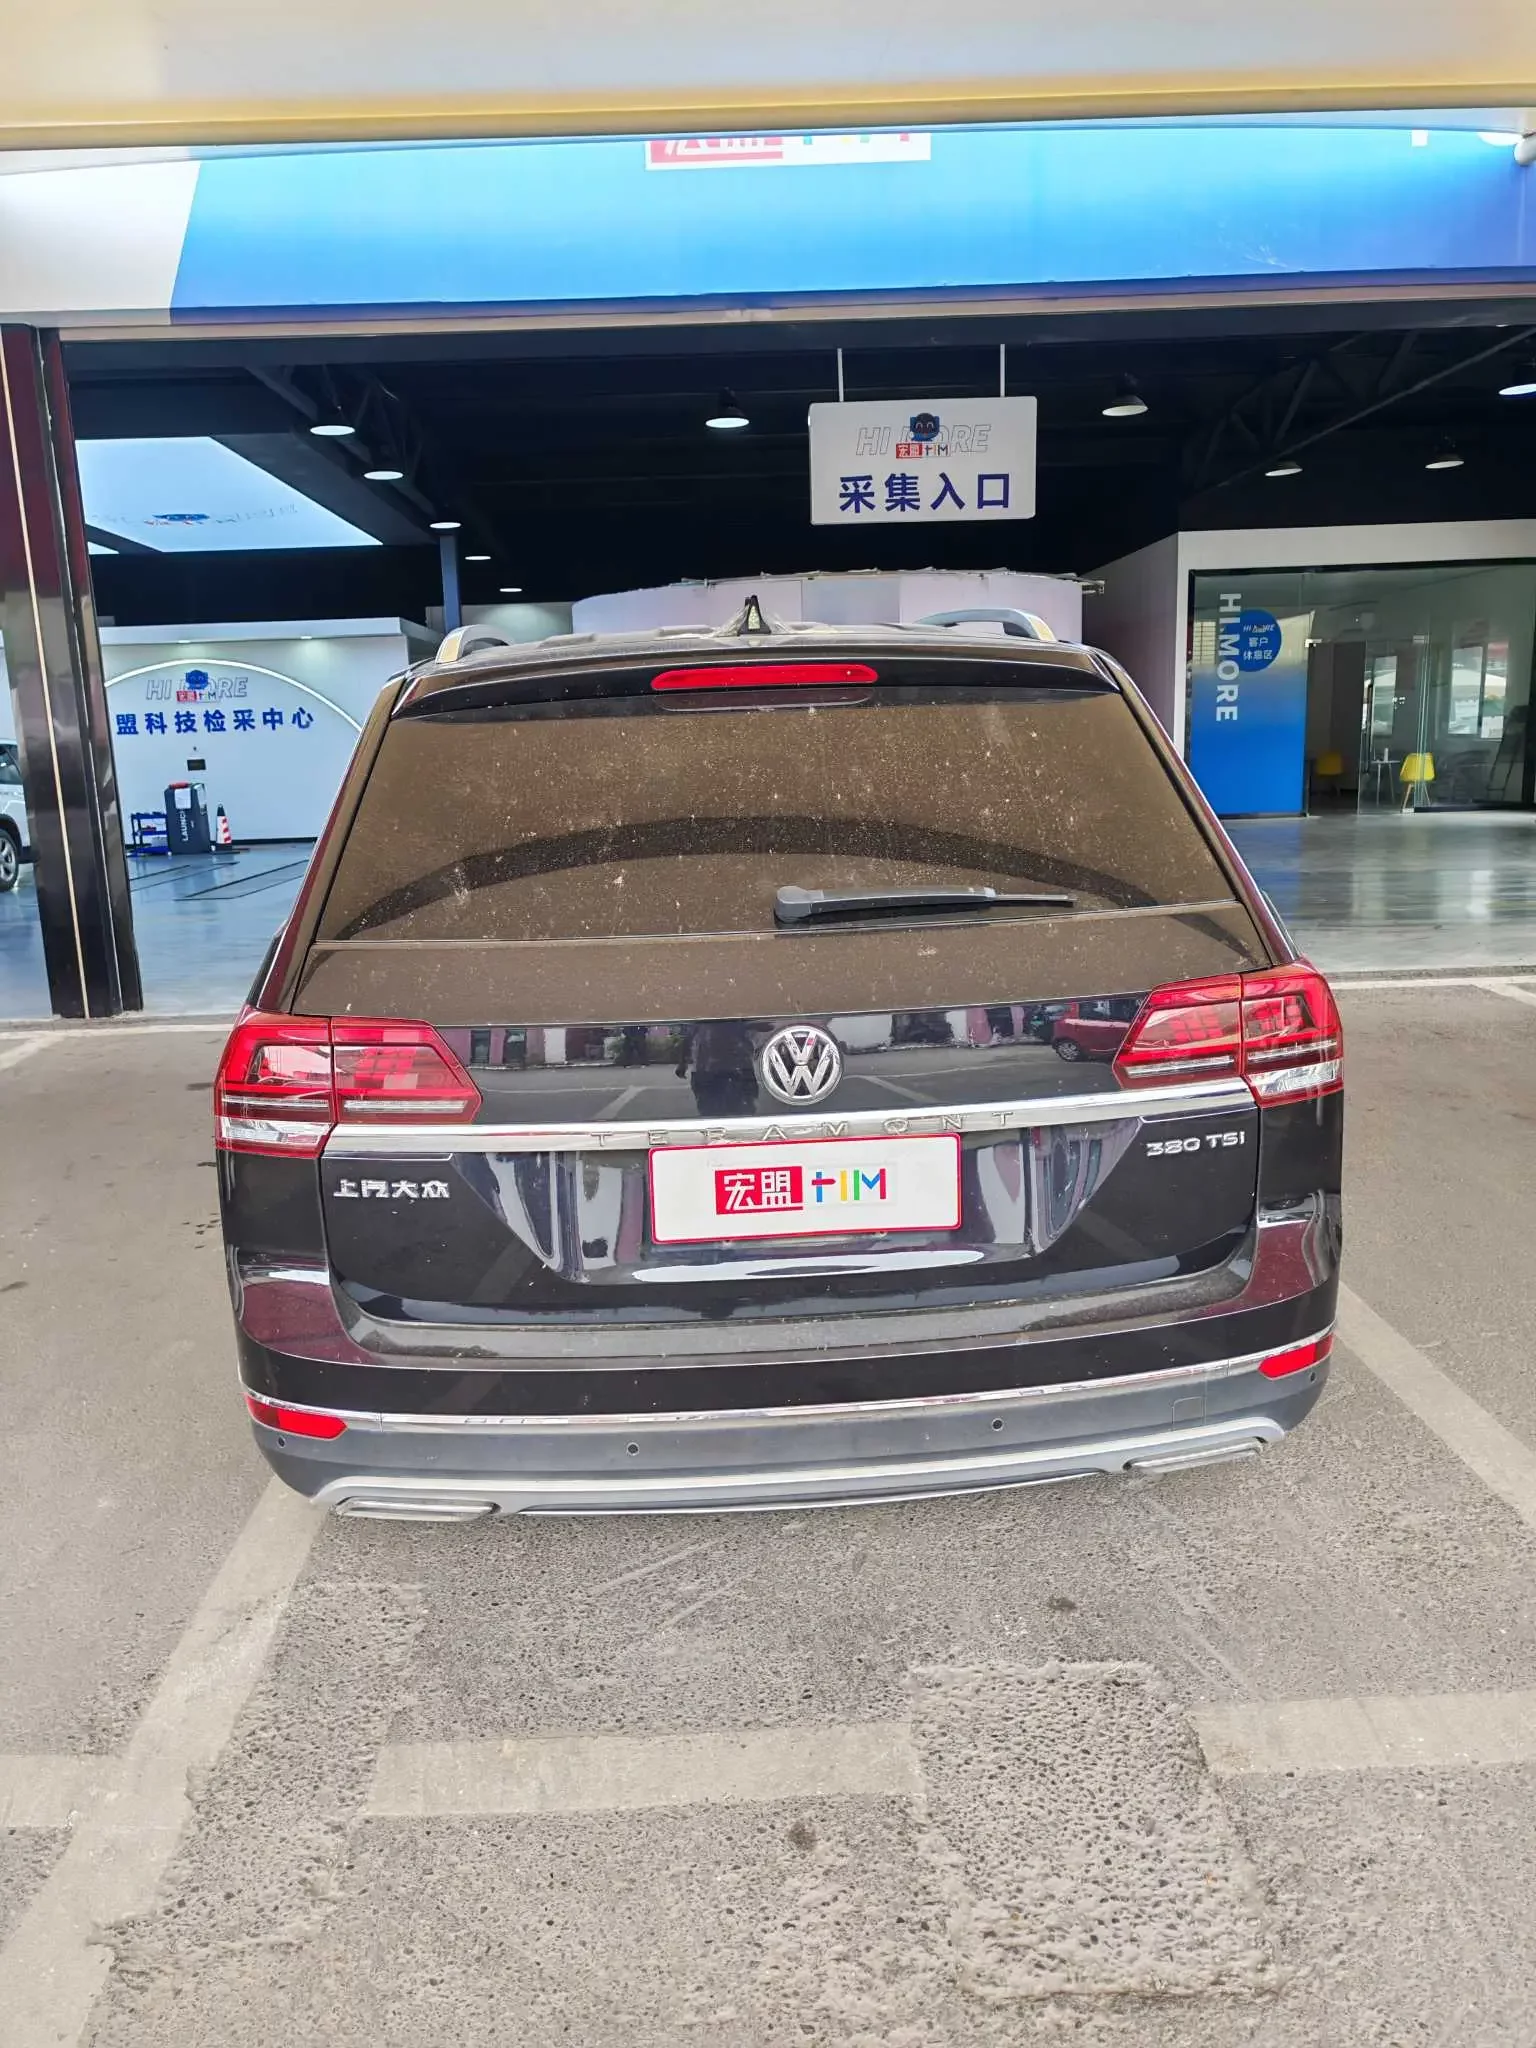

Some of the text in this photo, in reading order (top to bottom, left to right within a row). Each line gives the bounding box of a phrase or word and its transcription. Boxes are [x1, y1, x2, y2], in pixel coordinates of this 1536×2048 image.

[856, 426, 892, 456] HI
[839, 472, 1010, 513] 采集入口
[116, 706, 314, 736] 盟科技检采中心
[589, 1111, 1014, 1147] TERAMONT
[1146, 1130, 1246, 1157] 380 TSI
[332, 1179, 451, 1199] 上汽大众
[722, 1169, 797, 1211] 宏盟
